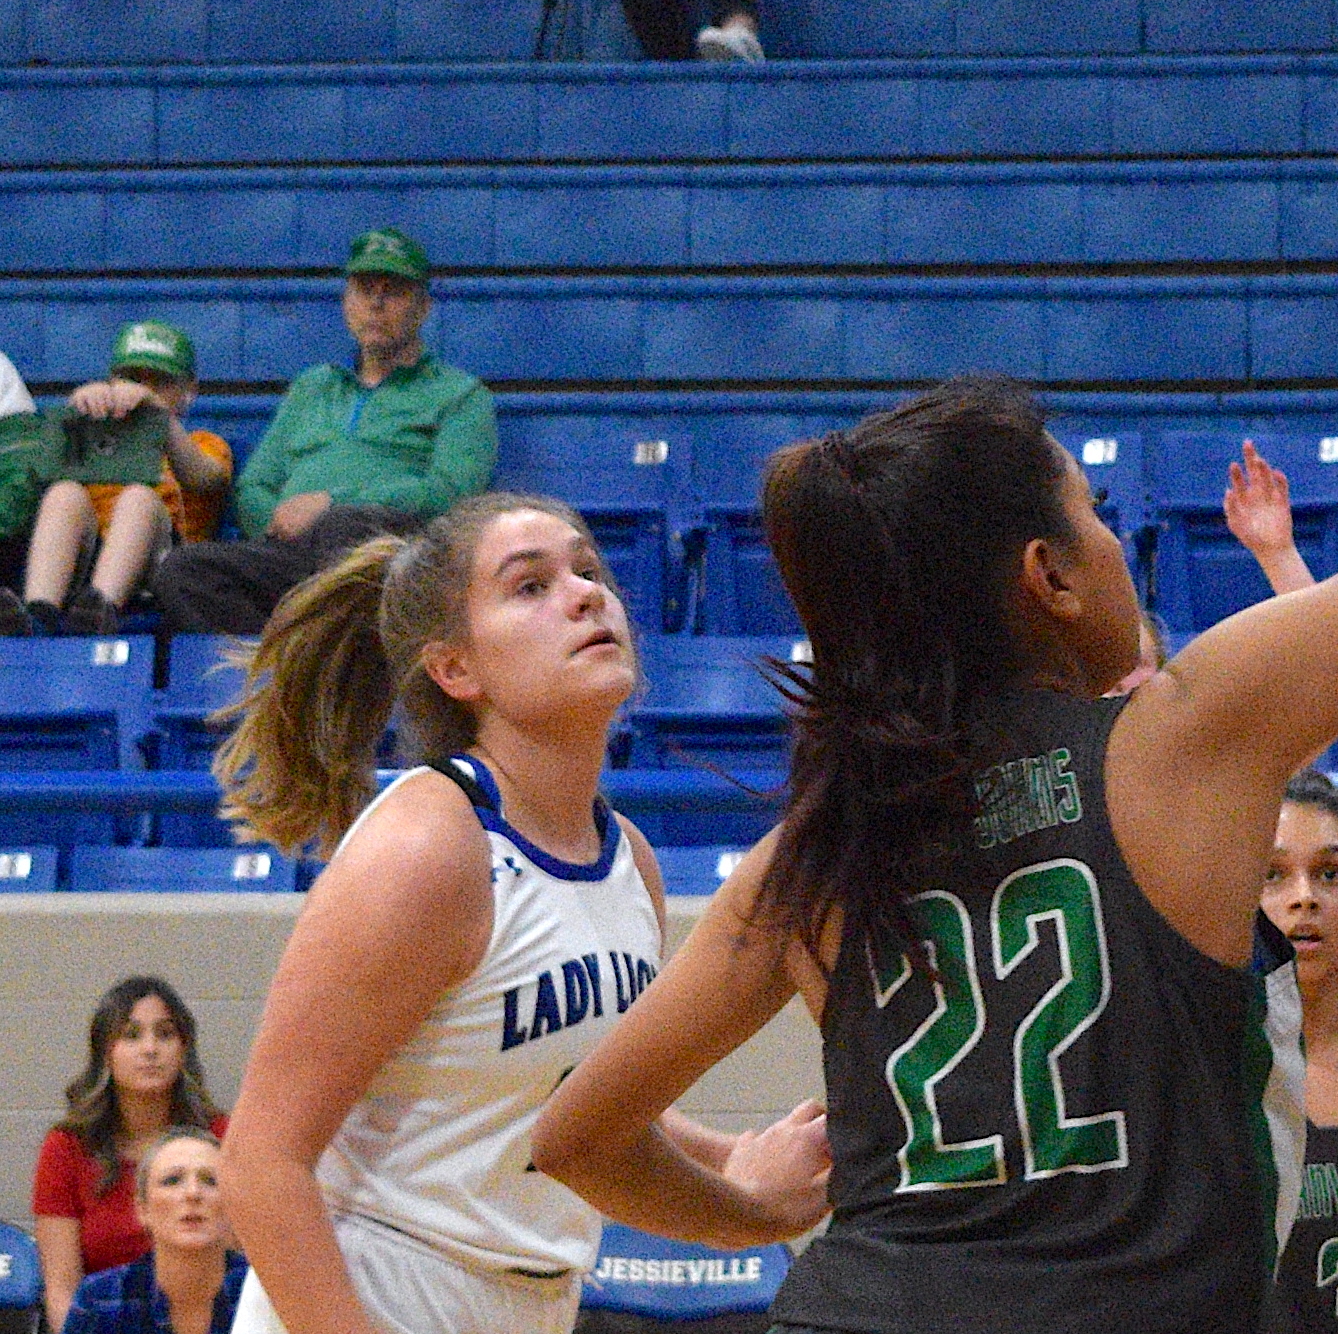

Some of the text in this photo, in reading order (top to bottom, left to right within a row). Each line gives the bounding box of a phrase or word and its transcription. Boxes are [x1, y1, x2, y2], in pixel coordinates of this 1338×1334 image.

[501, 952, 604, 1053] LADY
[866, 857, 1129, 1194] 22
[595, 1256, 763, 1285] JESSIEVILLE
